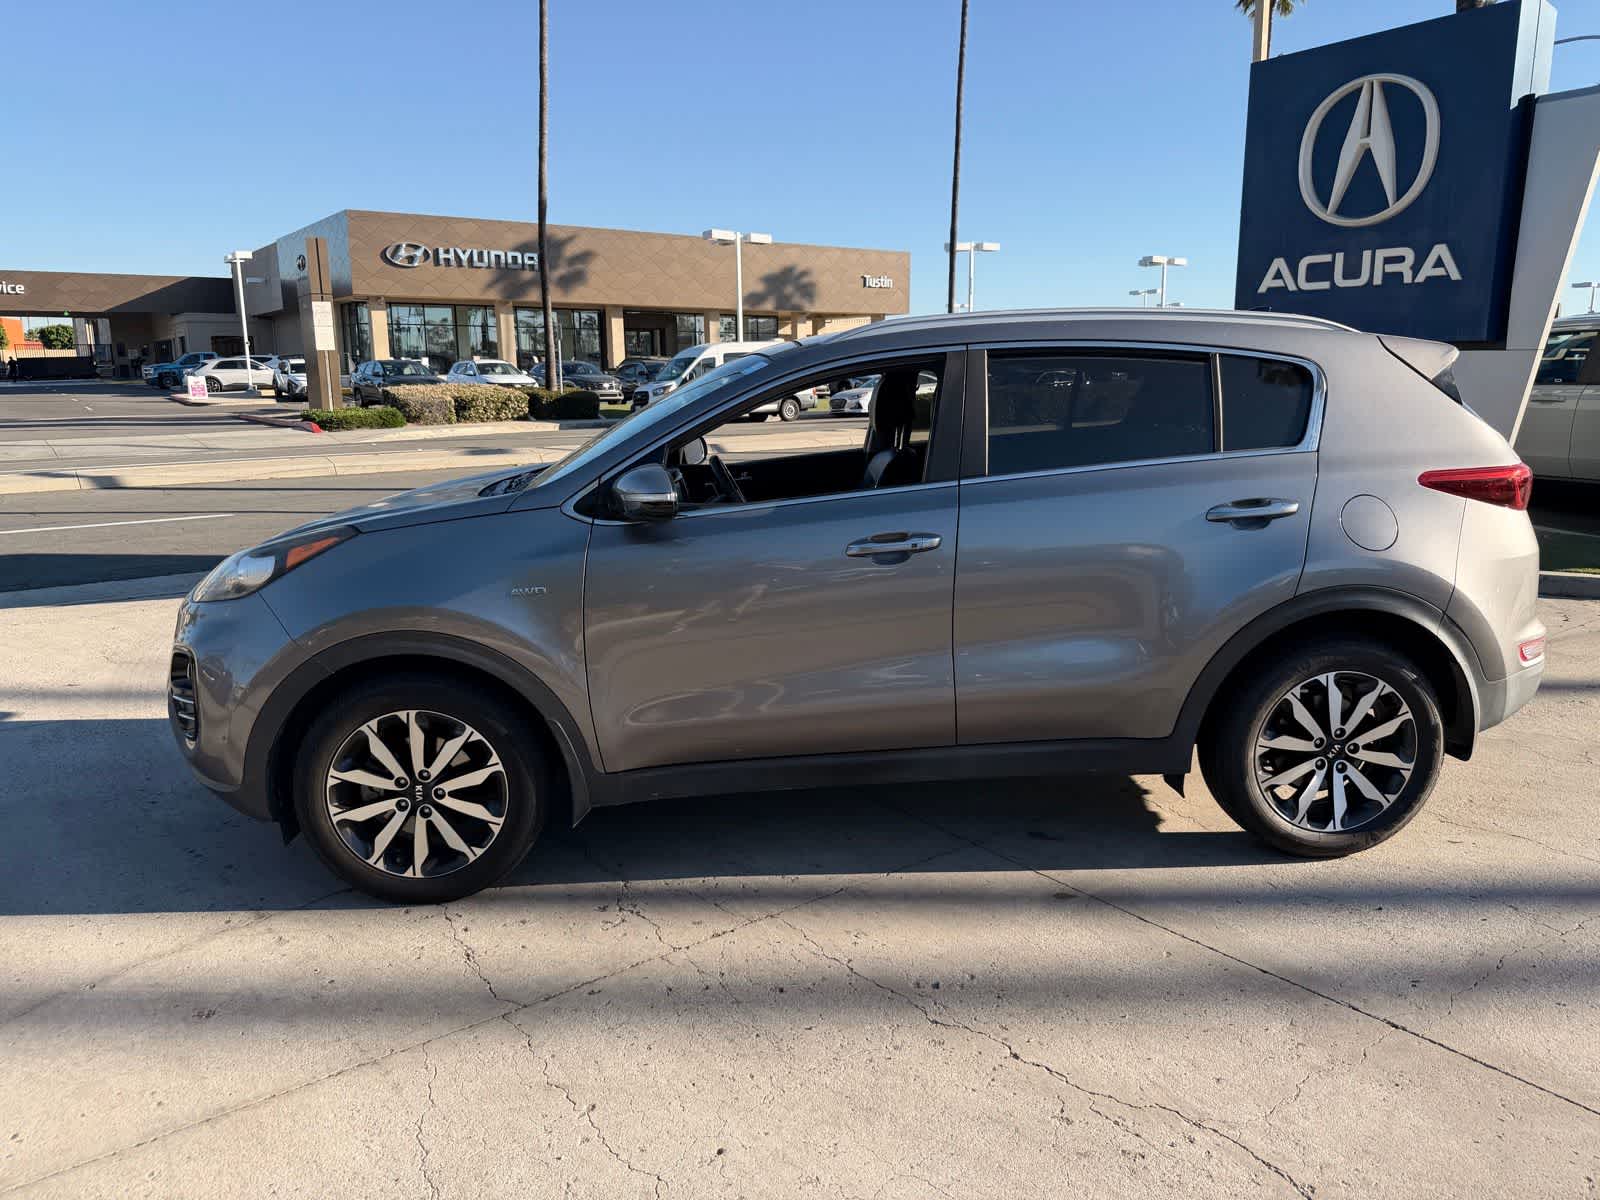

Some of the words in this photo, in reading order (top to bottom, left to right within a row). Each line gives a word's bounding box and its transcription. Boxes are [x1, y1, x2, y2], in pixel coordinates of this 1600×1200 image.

[434, 246, 539, 271] HYUNDA
[1257, 243, 1463, 294] ACURA
[862, 274, 893, 288] Tustin
[1327, 744, 1341, 758] KIA
[415, 785, 424, 801] KIA
